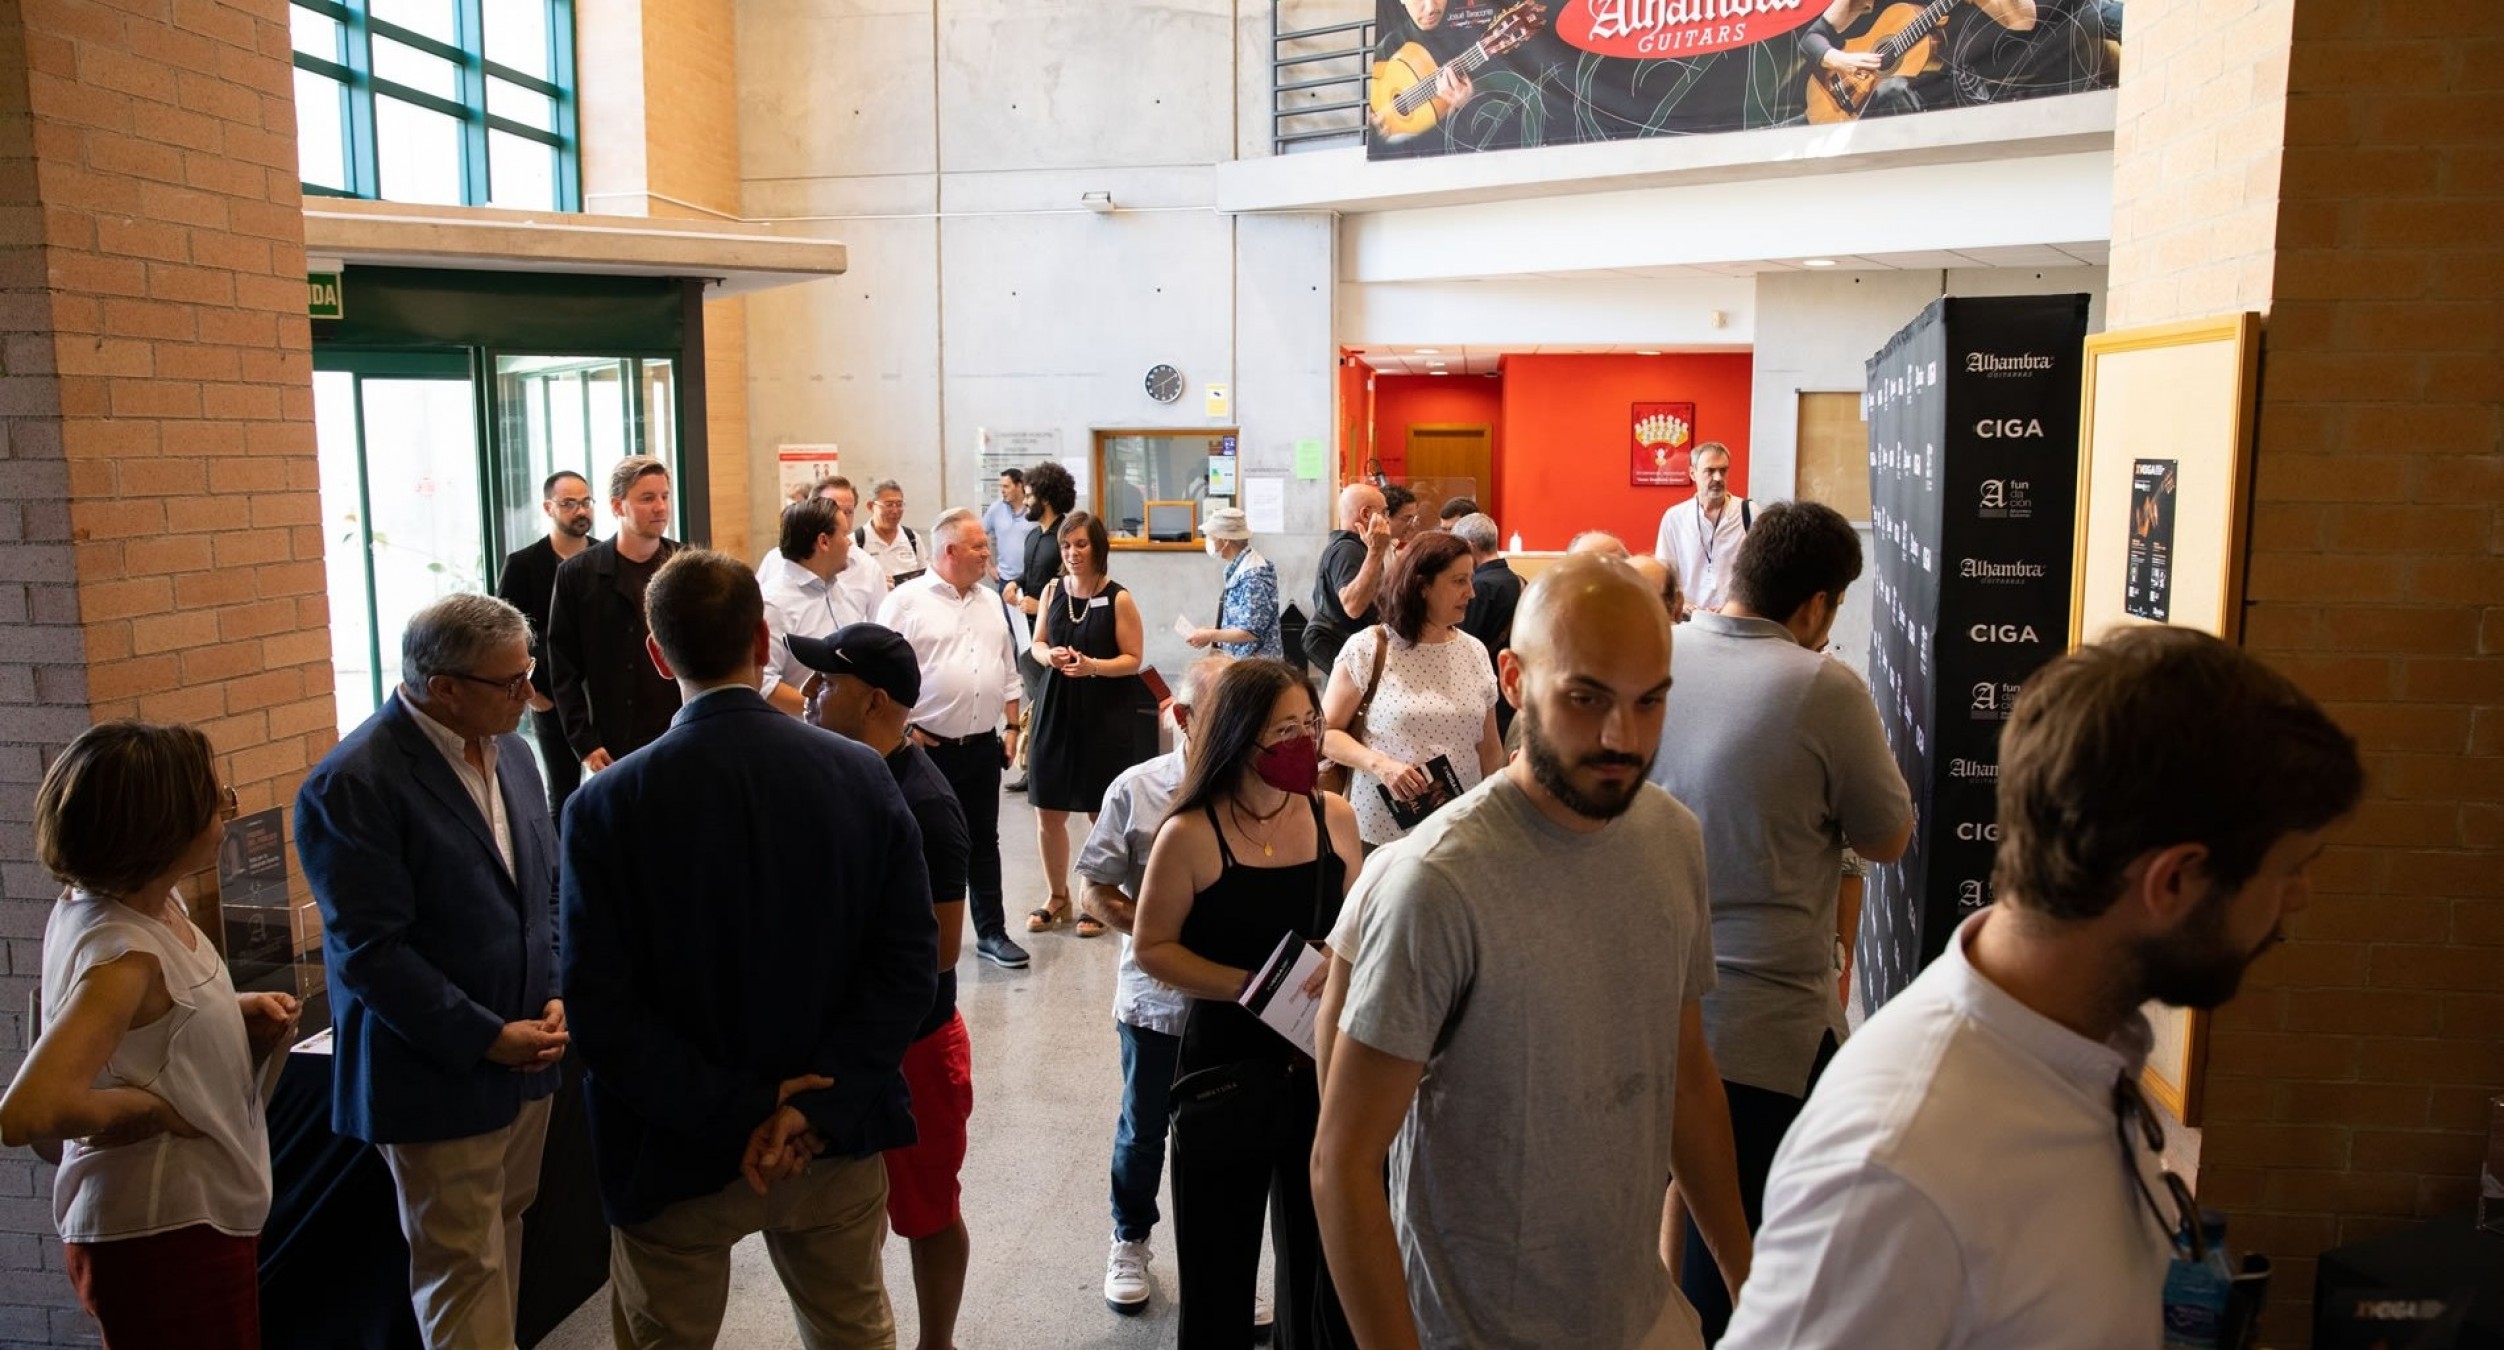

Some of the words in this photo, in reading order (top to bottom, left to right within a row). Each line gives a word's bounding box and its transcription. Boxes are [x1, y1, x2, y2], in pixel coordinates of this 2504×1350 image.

[1588, 0, 1801, 41] Alham
[1638, 23, 1746, 53] GUITARS
[307, 283, 337, 305] IDA
[1965, 352, 2055, 373] Alhambra
[1976, 418, 2044, 439] CIGA
[2010, 480, 2029, 489] fun
[1960, 558, 2046, 578] Alhambra
[1969, 624, 2040, 643] CIGA
[1949, 758, 1999, 777] Alham
[1957, 822, 2000, 841] CIG
